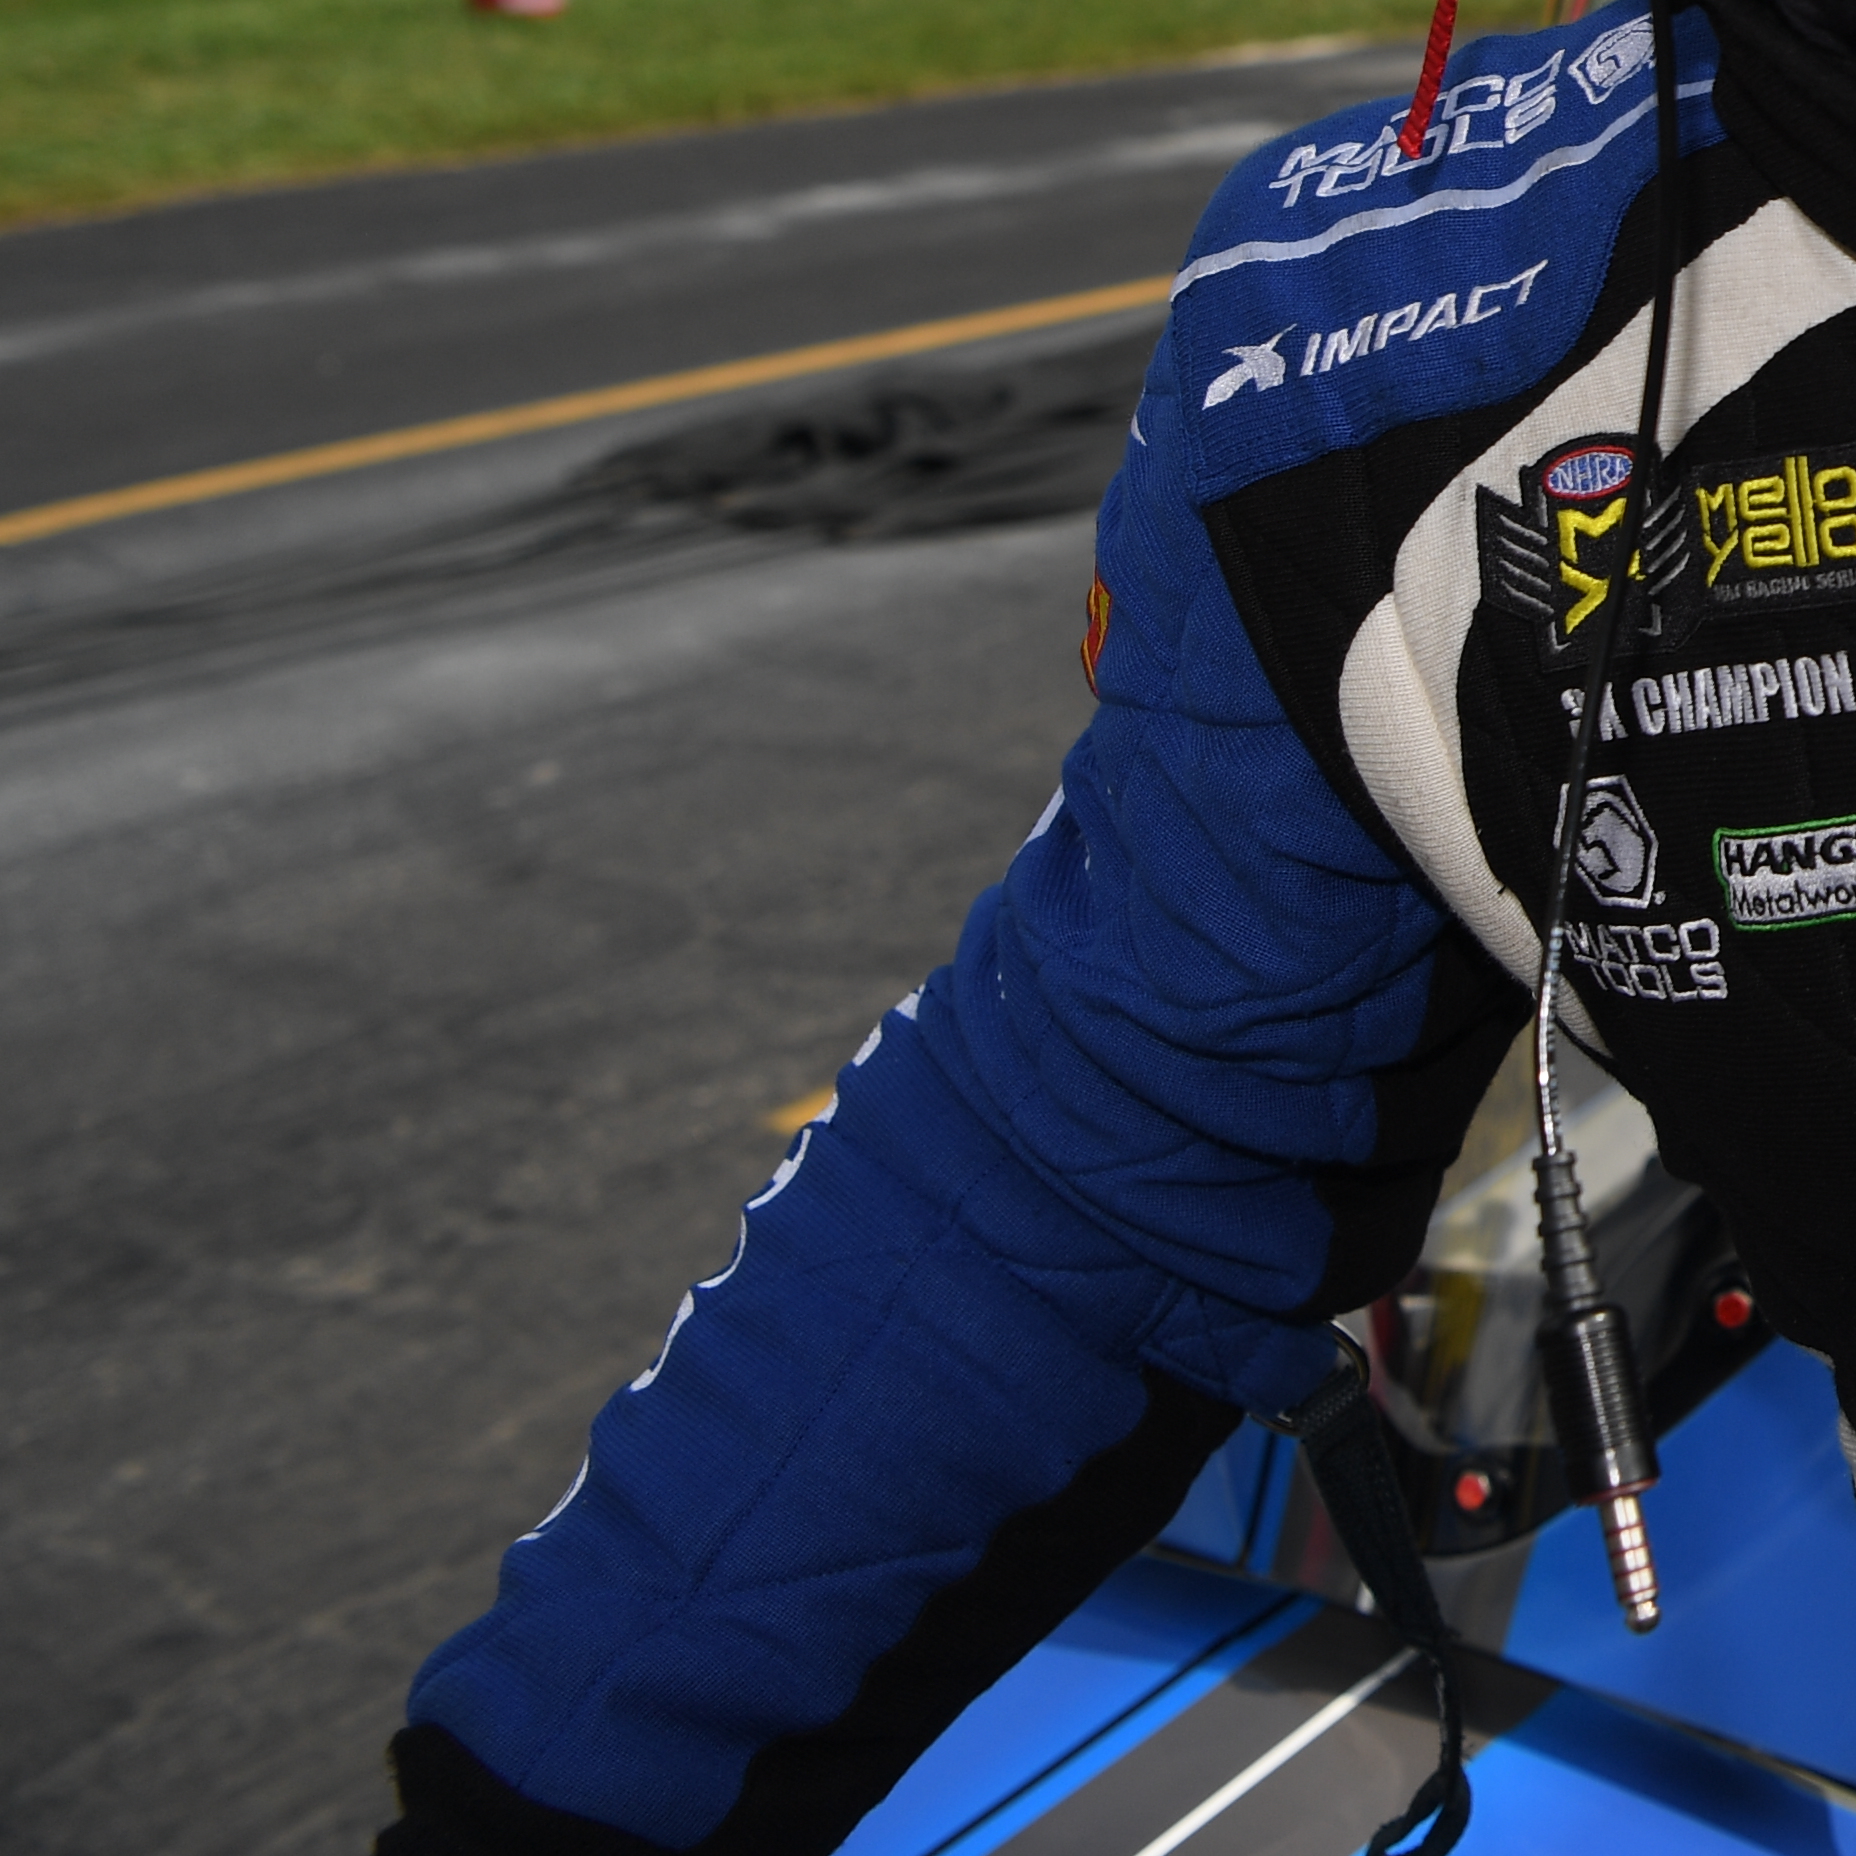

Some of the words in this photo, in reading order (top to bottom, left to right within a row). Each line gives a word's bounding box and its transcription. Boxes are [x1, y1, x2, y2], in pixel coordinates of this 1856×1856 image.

[1300, 259, 1549, 378] IMPACT
[1550, 453, 1631, 492] NHRA
[1564, 917, 1720, 964] MATCO
[1573, 955, 1728, 1003] TOOLS
